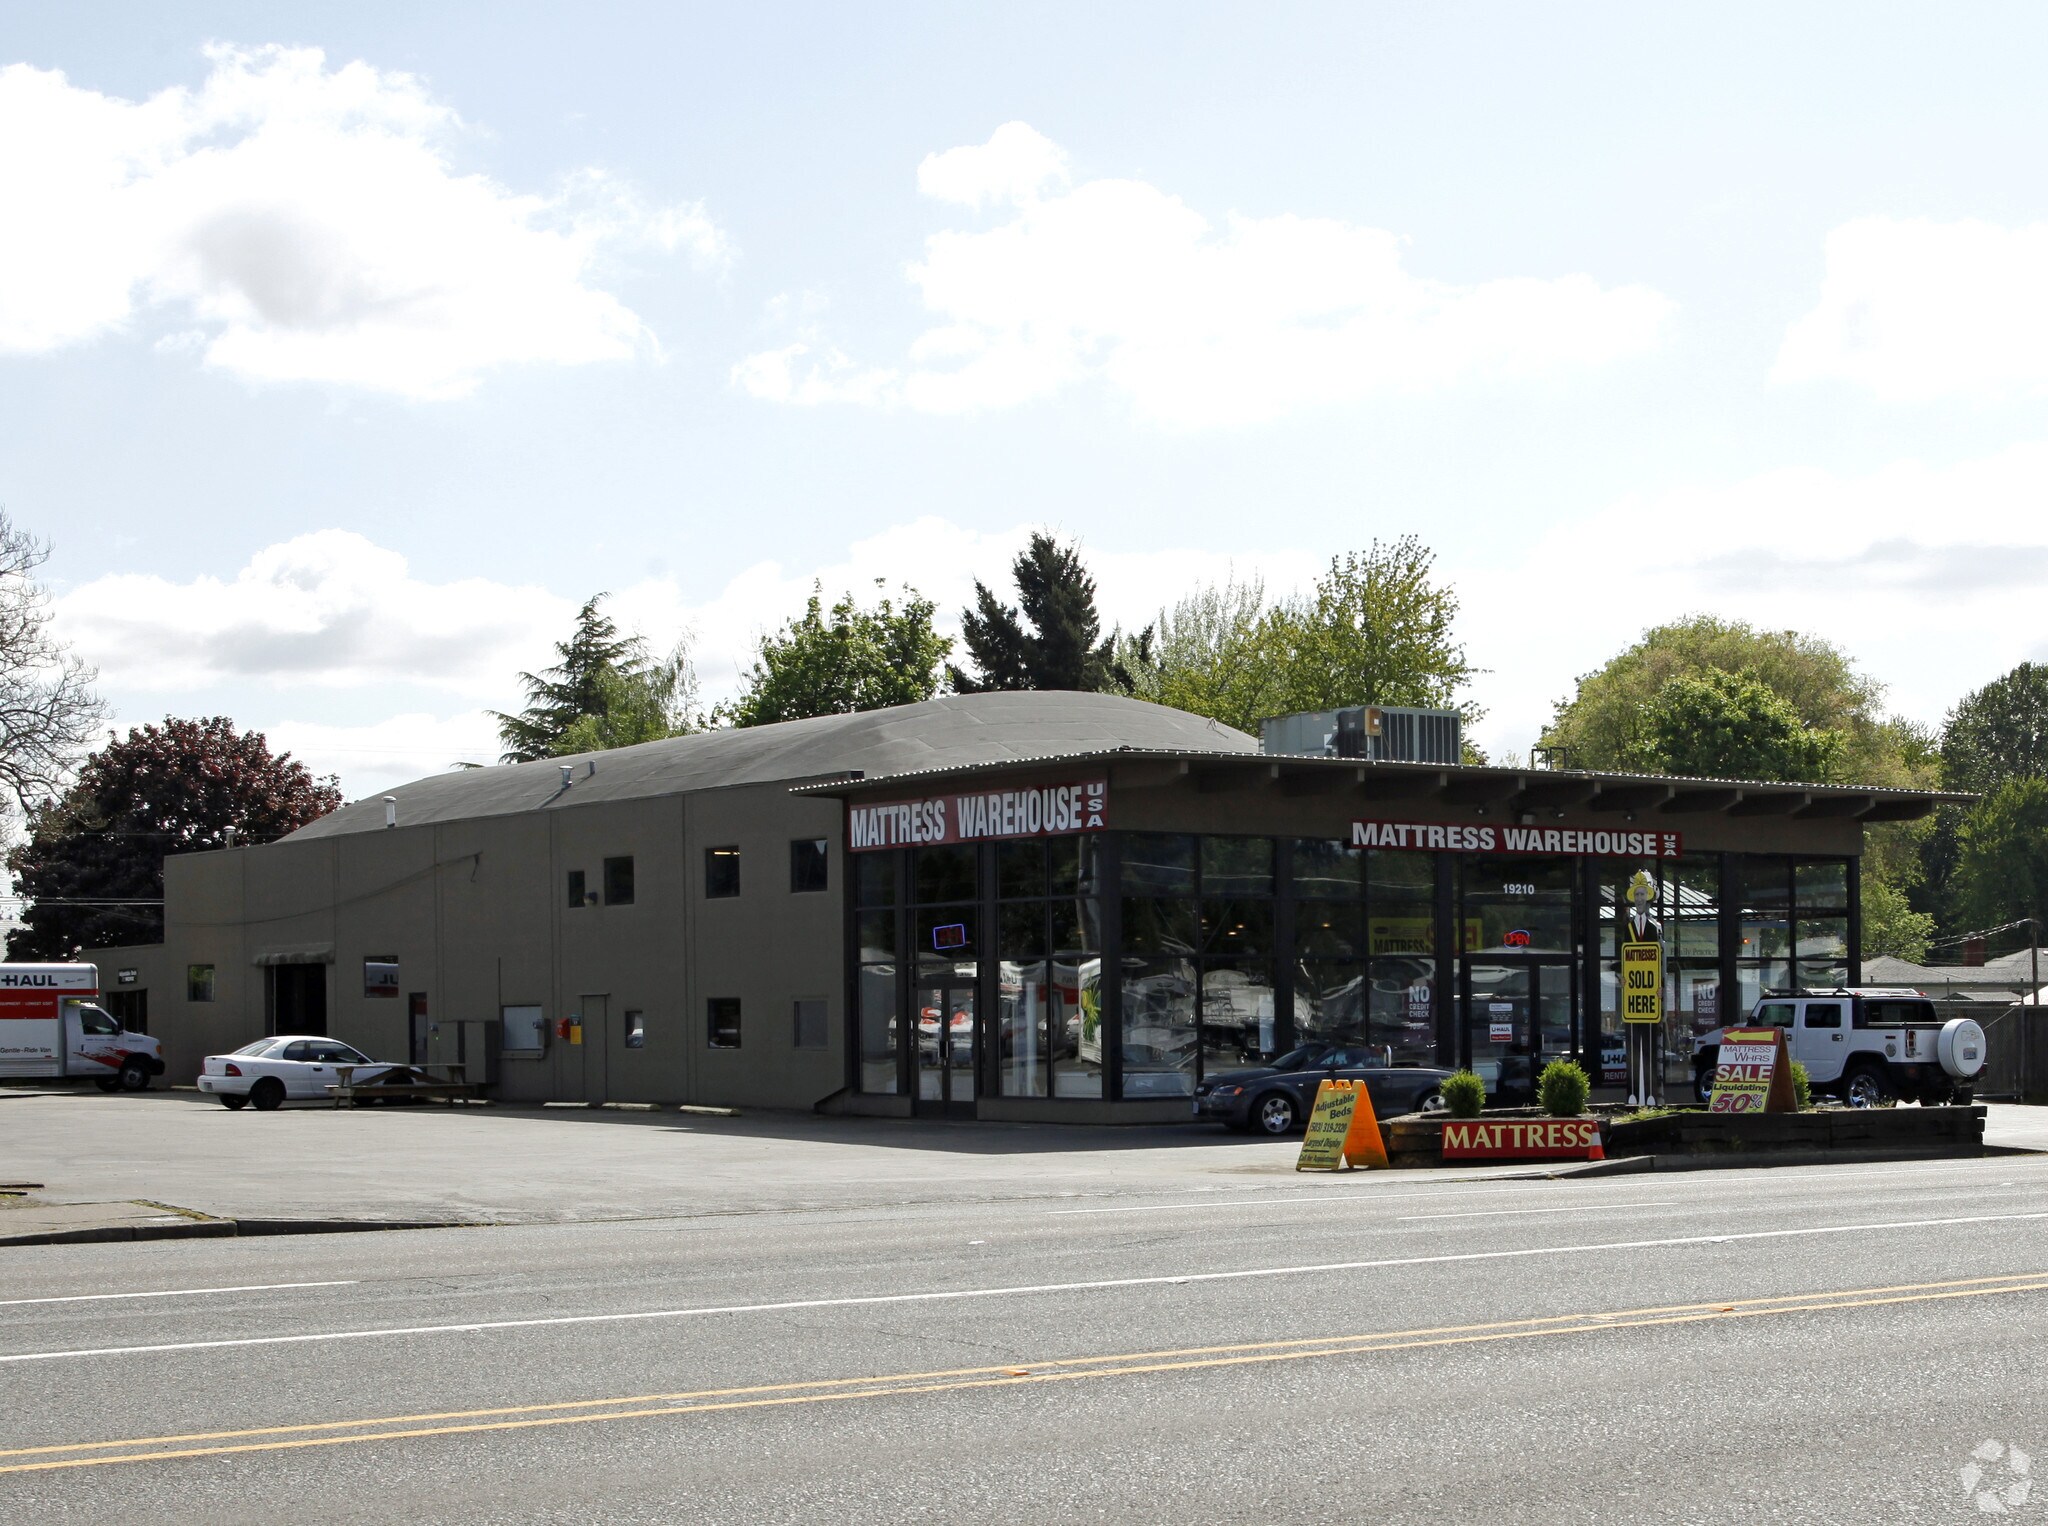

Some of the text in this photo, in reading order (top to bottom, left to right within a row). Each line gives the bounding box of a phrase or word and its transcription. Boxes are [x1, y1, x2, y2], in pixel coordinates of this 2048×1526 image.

[1087, 783, 1103, 828] USA
[851, 785, 1082, 848] MATTRESS WAREHOUSE
[1352, 822, 1657, 855] MATTRESS WAREHOUSE
[1663, 834, 1677, 856] USA
[1503, 883, 1534, 895] 19210
[1503, 932, 1530, 945] OPEN
[1625, 949, 1657, 961] MATTRESSES
[1628, 970, 1654, 989] SOLD
[1408, 986, 1430, 1003] NO
[1698, 984, 1716, 1000] NO
[1409, 1003, 1430, 1011] CREDIT
[1628, 995, 1655, 1013] HERE
[1409, 1010, 1430, 1018] CHECK
[1724, 1045, 1772, 1053] MATTRESS
[1715, 1065, 1773, 1082] SALE
[1713, 1083, 1768, 1093] Liquidating
[1315, 1094, 1354, 1112] Adjustable
[1711, 1093, 1763, 1113] 50%
[1330, 1106, 1352, 1119] Beds
[1444, 1124, 1592, 1149] MATTRESS
